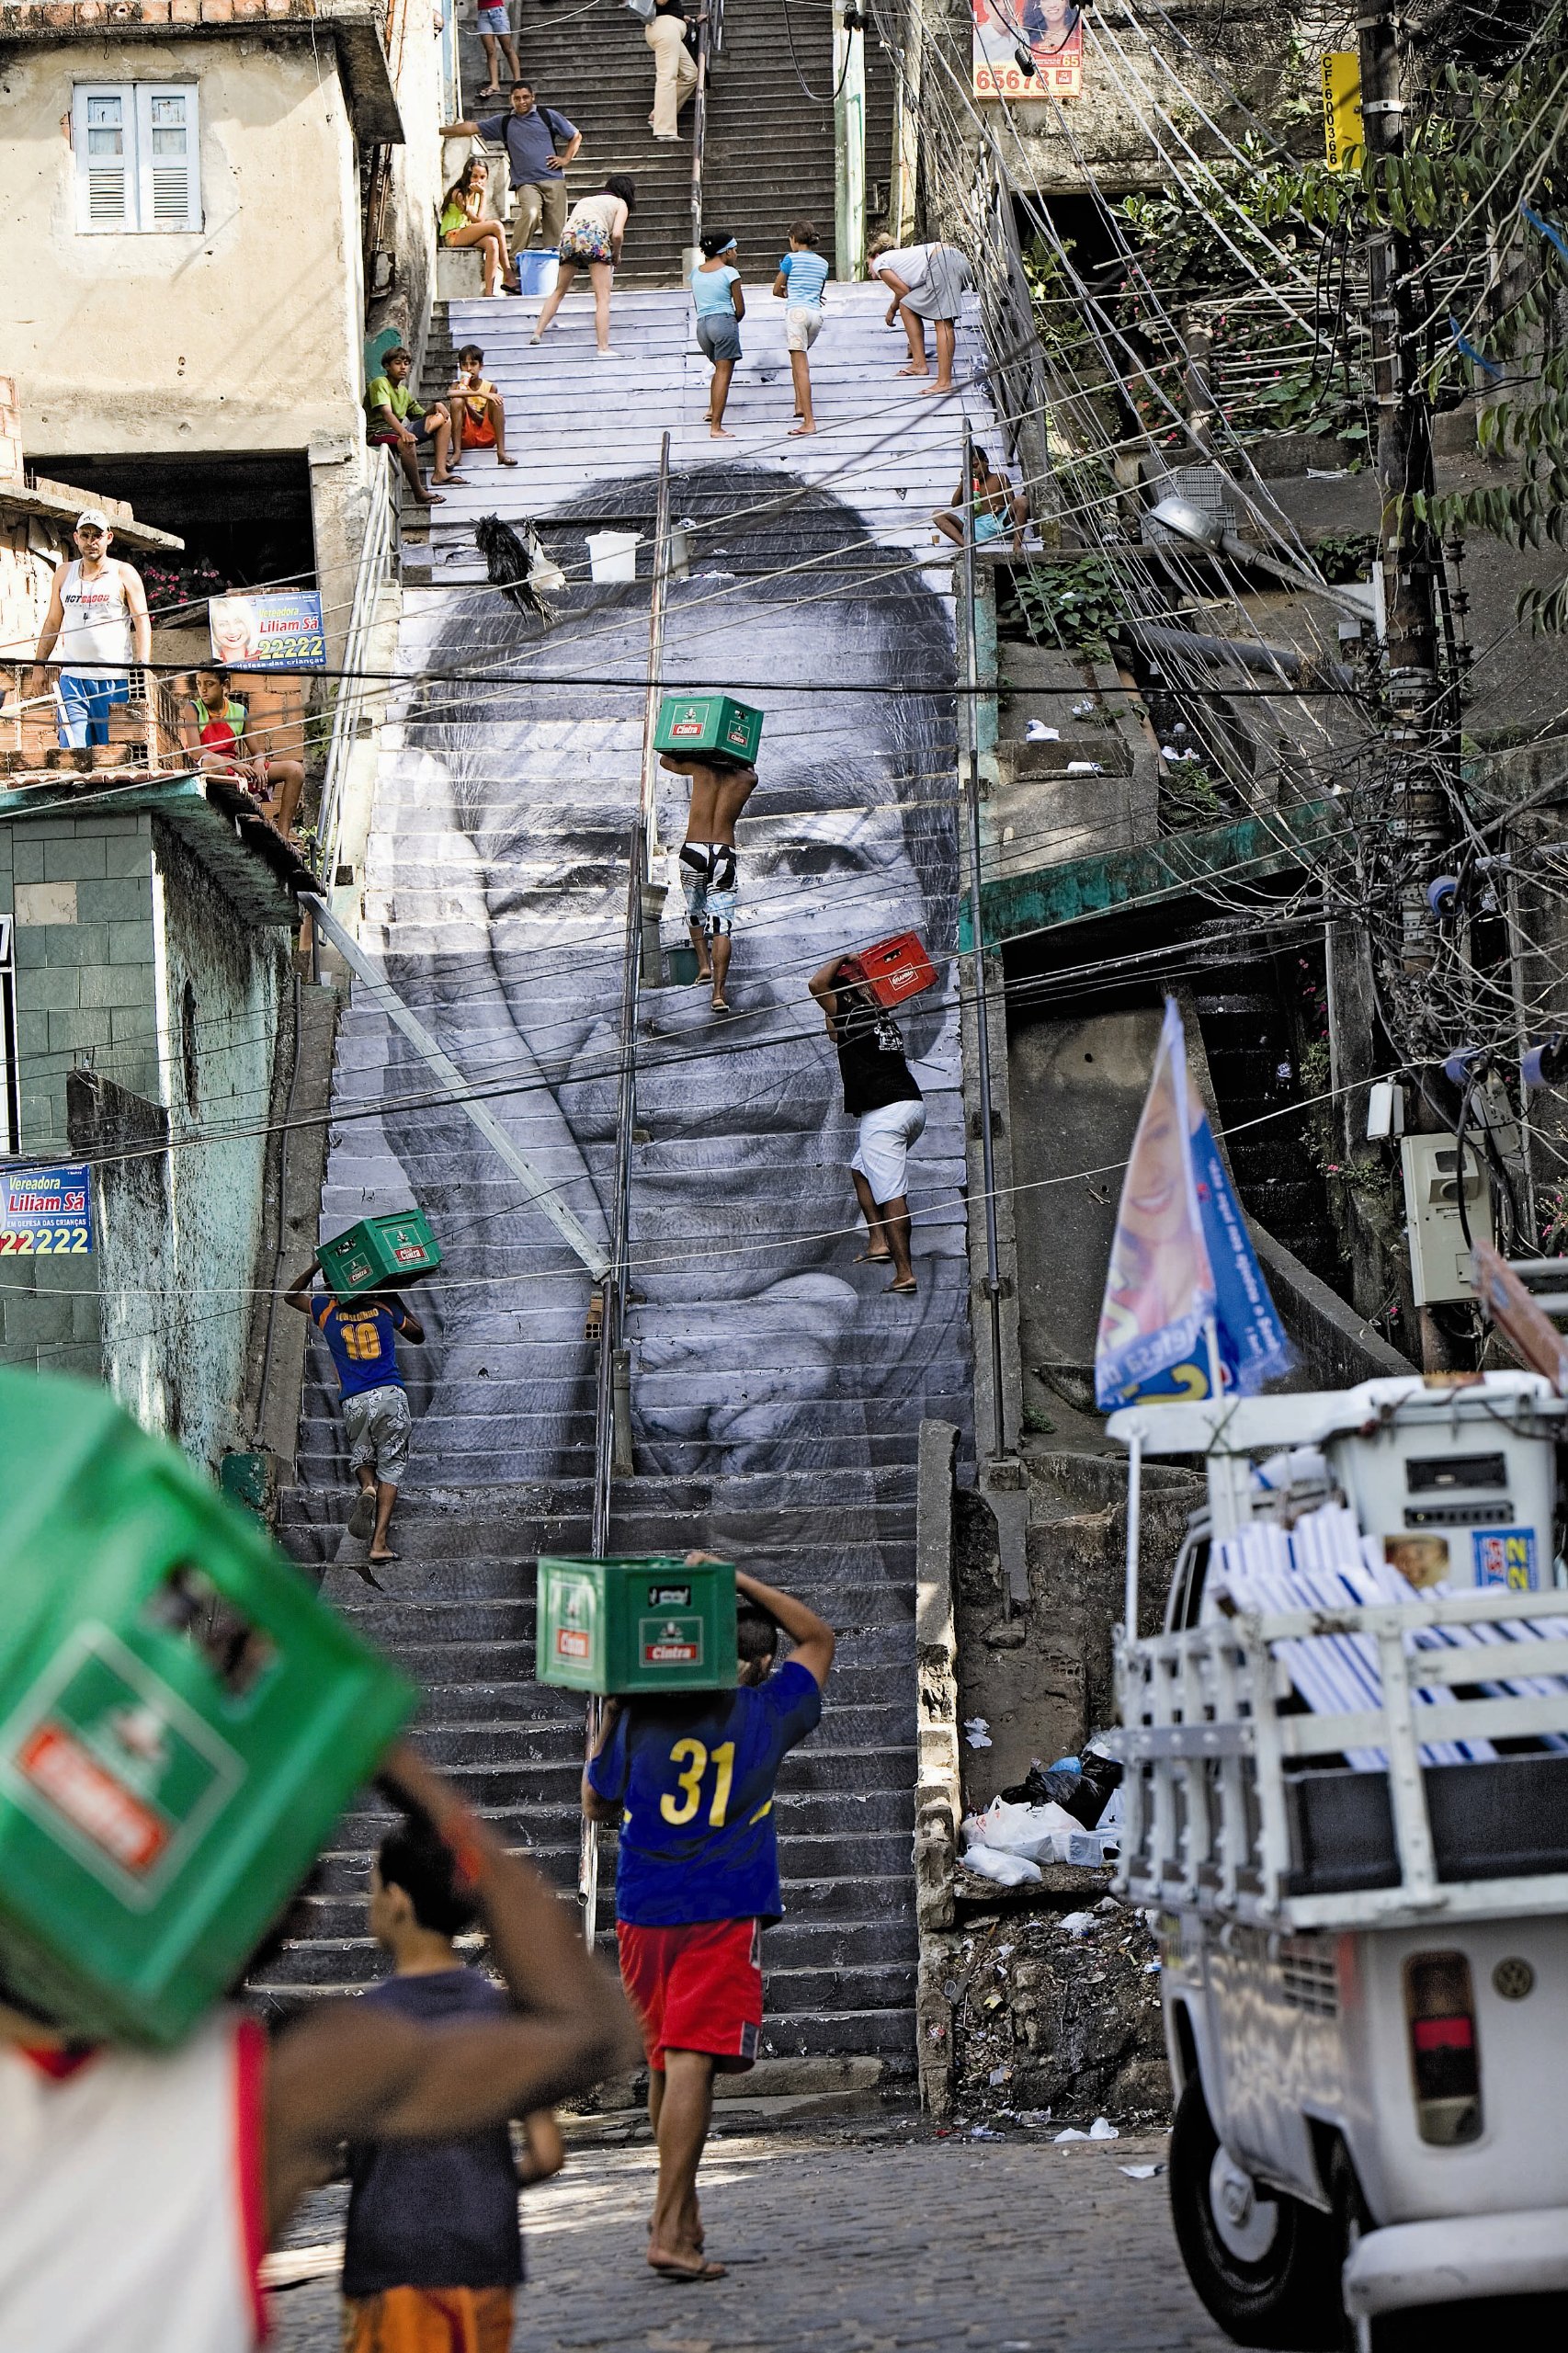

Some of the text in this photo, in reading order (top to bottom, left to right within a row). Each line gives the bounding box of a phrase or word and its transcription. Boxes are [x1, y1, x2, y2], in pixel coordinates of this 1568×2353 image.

[1062, 56, 1079, 66] 65
[1323, 57, 1338, 165] CF-600366
[259, 608, 299, 618] Vereadora
[260, 616, 319, 633] Liliam Sá
[258, 634, 324, 660] 22222
[9, 1176, 61, 1190] Vereadora
[9, 1192, 85, 1211] Liliam Sá
[56, 1218, 86, 1227] CRIANÇAS
[341, 1323, 381, 1360] 10
[652, 1645, 691, 1660] Cintra
[660, 1737, 735, 1827] 31
